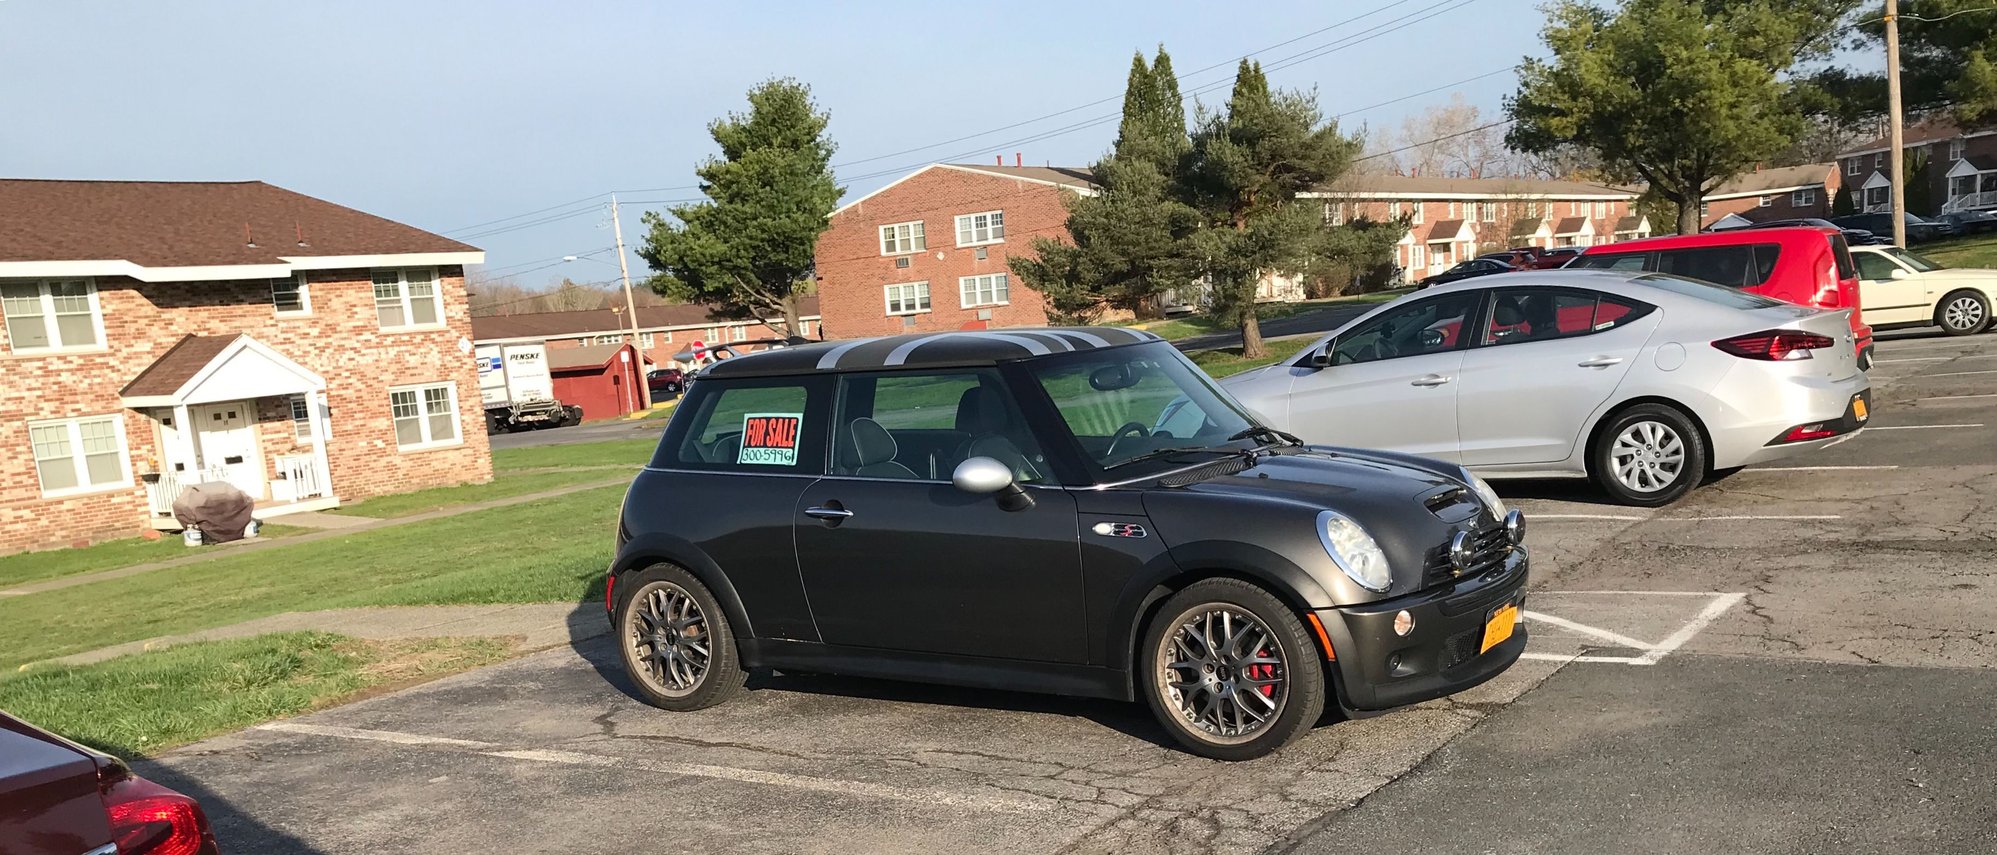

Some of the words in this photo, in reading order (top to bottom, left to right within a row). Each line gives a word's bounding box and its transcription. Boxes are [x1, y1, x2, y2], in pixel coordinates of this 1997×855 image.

[510, 353, 540, 361] PENSKE
[745, 418, 766, 447] FOR
[766, 418, 797, 447] SALE
[742, 449, 791, 462] 300-5996
